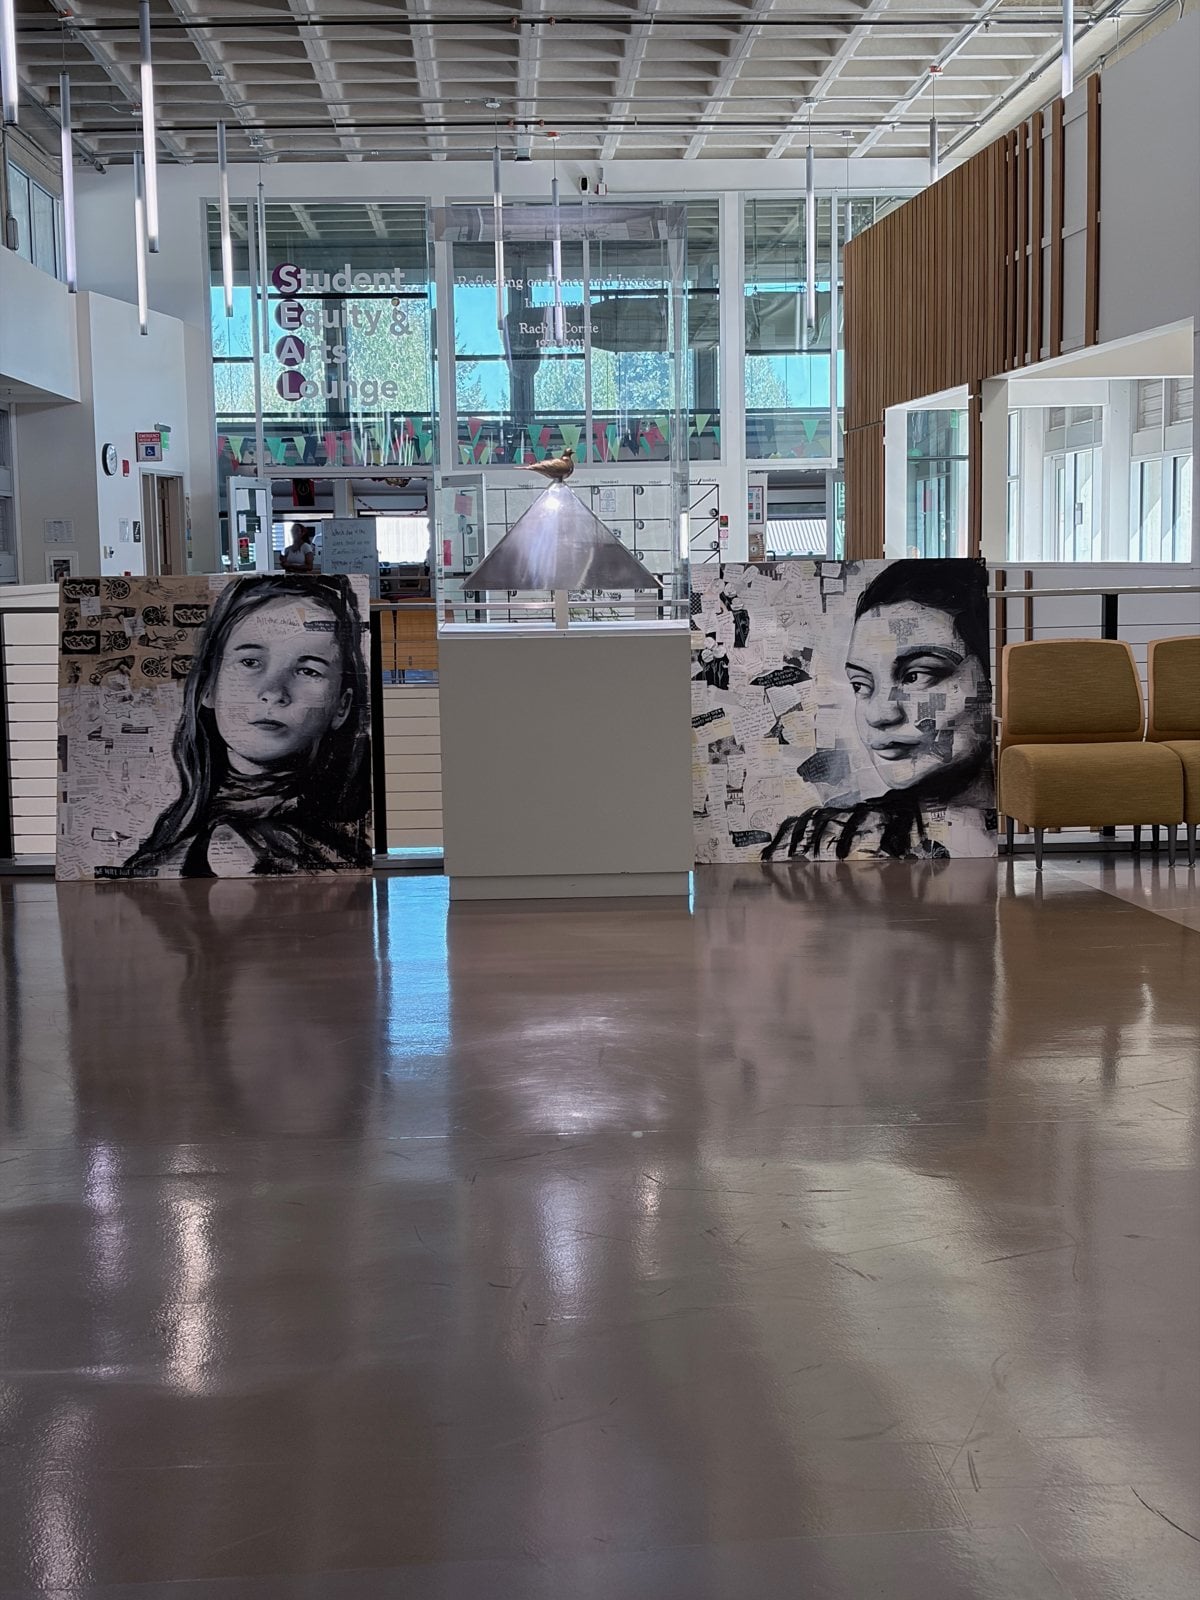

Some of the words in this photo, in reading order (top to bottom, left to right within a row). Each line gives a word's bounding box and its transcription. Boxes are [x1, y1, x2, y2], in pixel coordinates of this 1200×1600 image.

[279, 264, 405, 293] Student
[457, 275, 524, 290] Reflecing
[527, 279, 544, 288] on
[524, 298, 536, 309] In
[280, 301, 382, 337] Equity
[389, 307, 412, 336] &
[519, 322, 559, 334] Rach
[563, 322, 600, 334] Corie
[279, 337, 347, 364] Arts
[281, 373, 399, 406] Lounge
